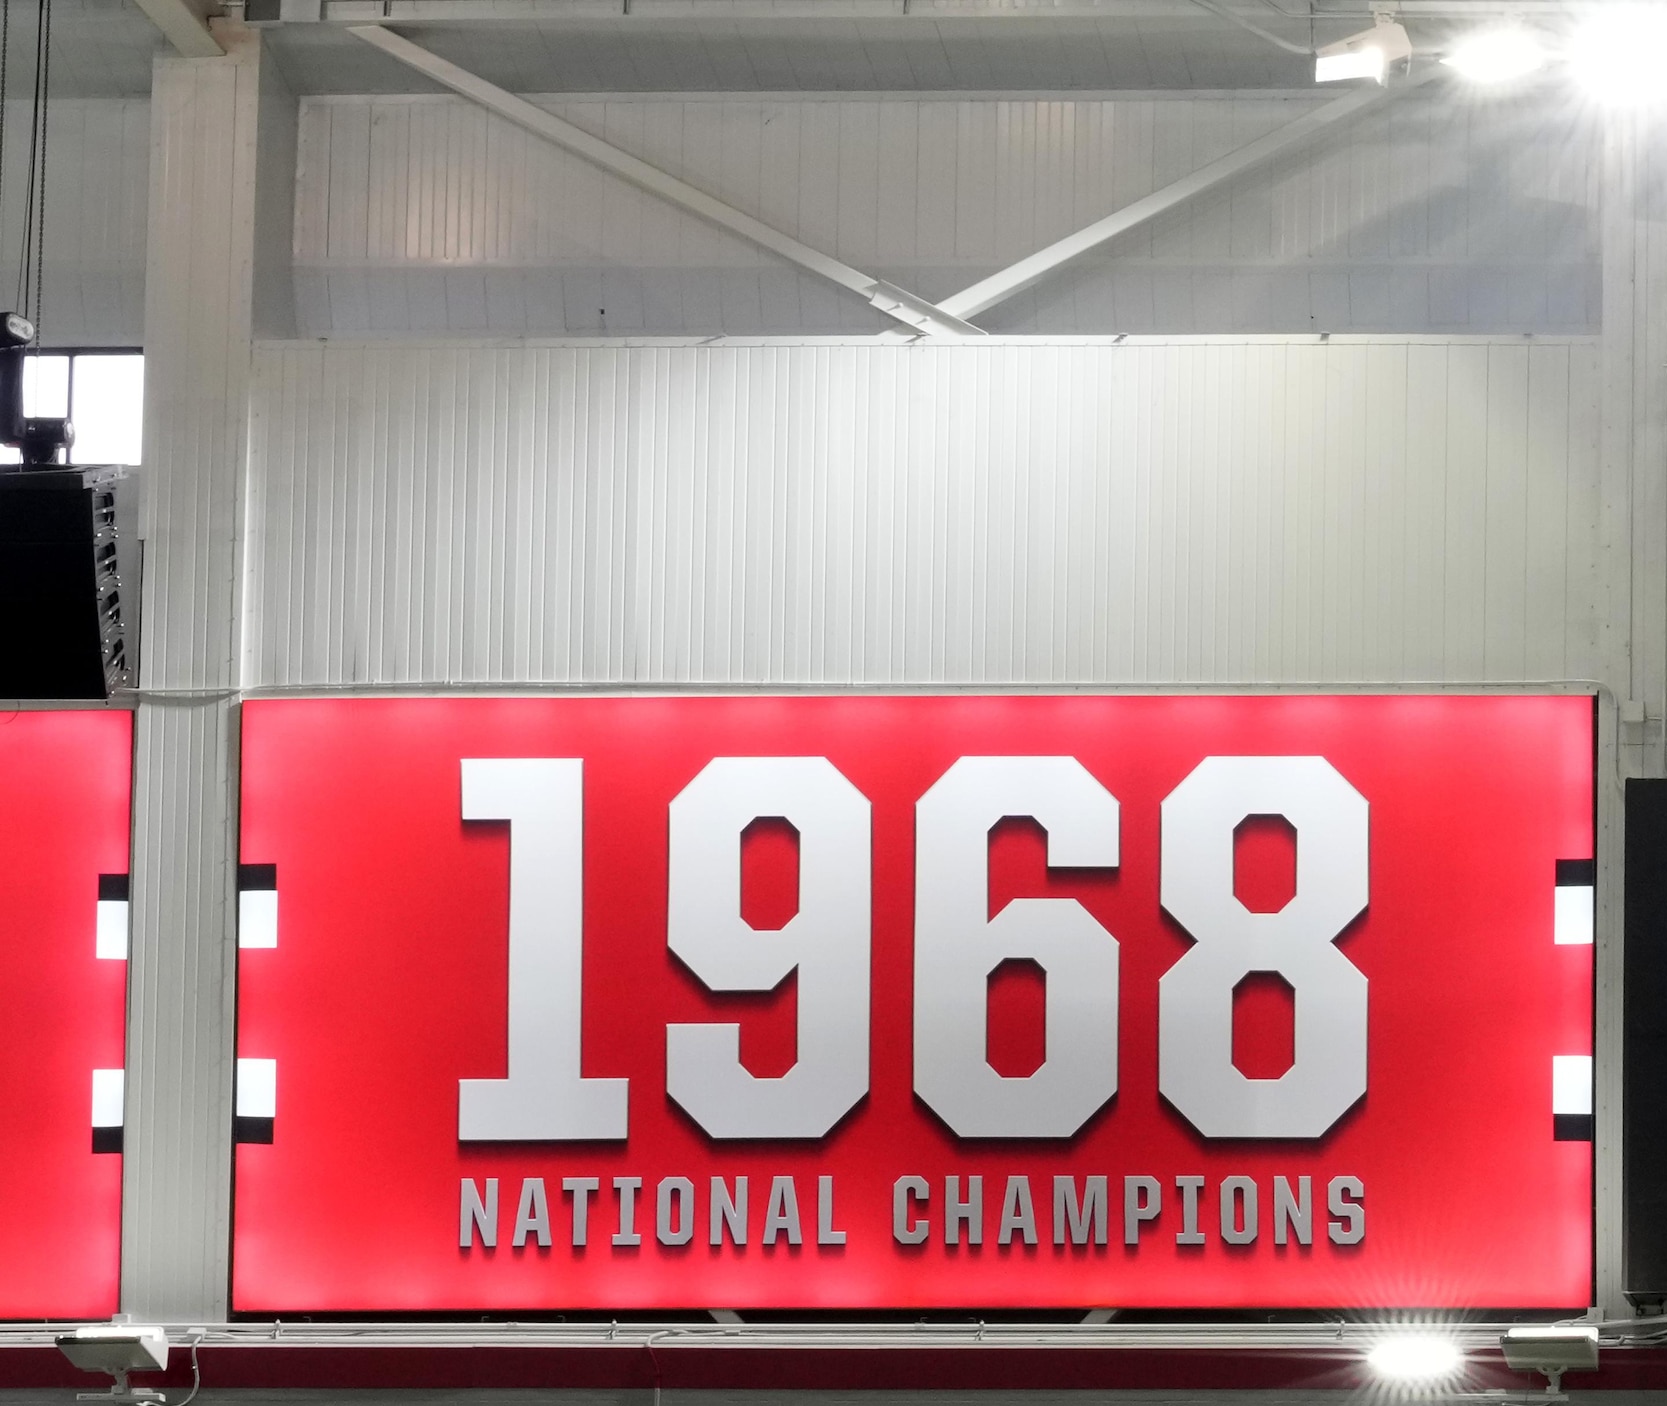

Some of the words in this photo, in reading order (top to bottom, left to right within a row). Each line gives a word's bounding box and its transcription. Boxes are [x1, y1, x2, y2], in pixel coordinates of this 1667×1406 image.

[458, 755, 1370, 1141] 1968
[460, 1176, 846, 1247] NATIONAL
[893, 1175, 1365, 1245] CHAMPIONS
